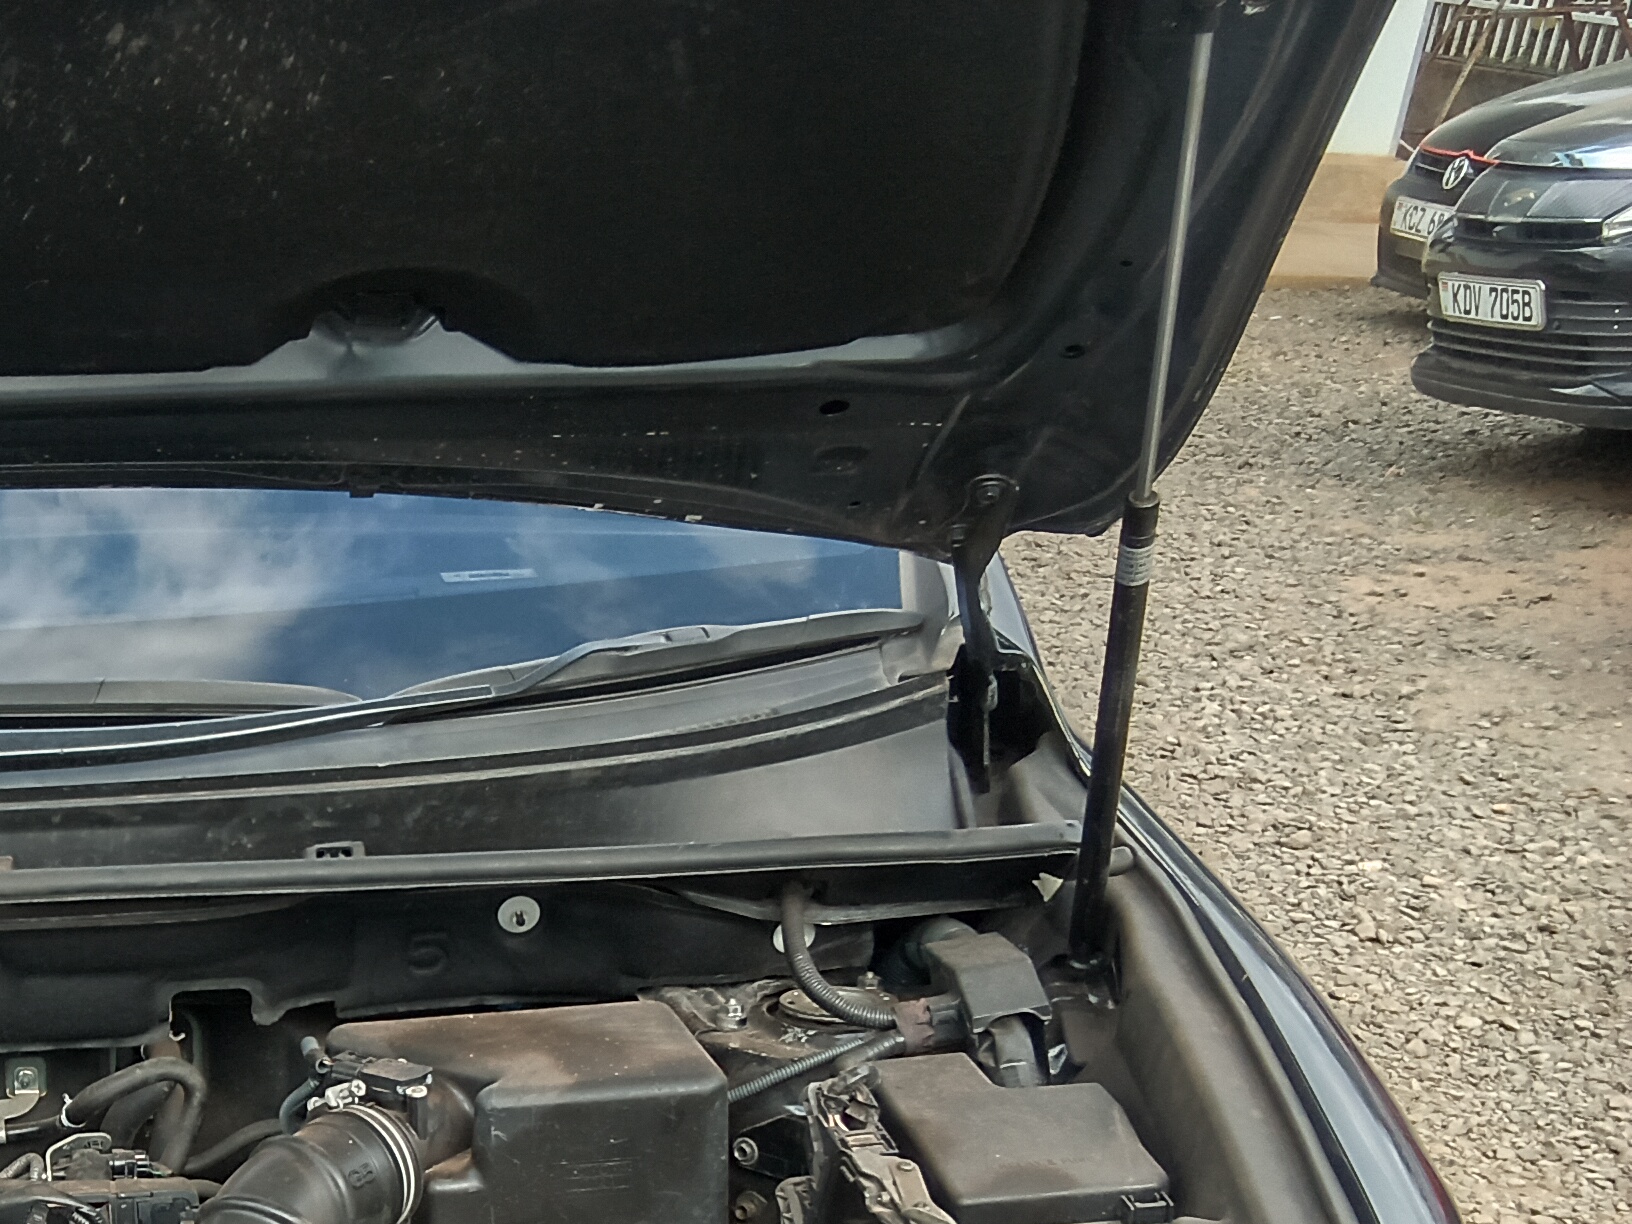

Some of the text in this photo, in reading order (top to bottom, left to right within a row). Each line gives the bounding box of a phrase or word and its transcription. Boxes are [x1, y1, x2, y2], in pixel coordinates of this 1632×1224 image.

[1400, 204, 1427, 234] KCZ
[1451, 282, 1534, 323] KDV 705B
